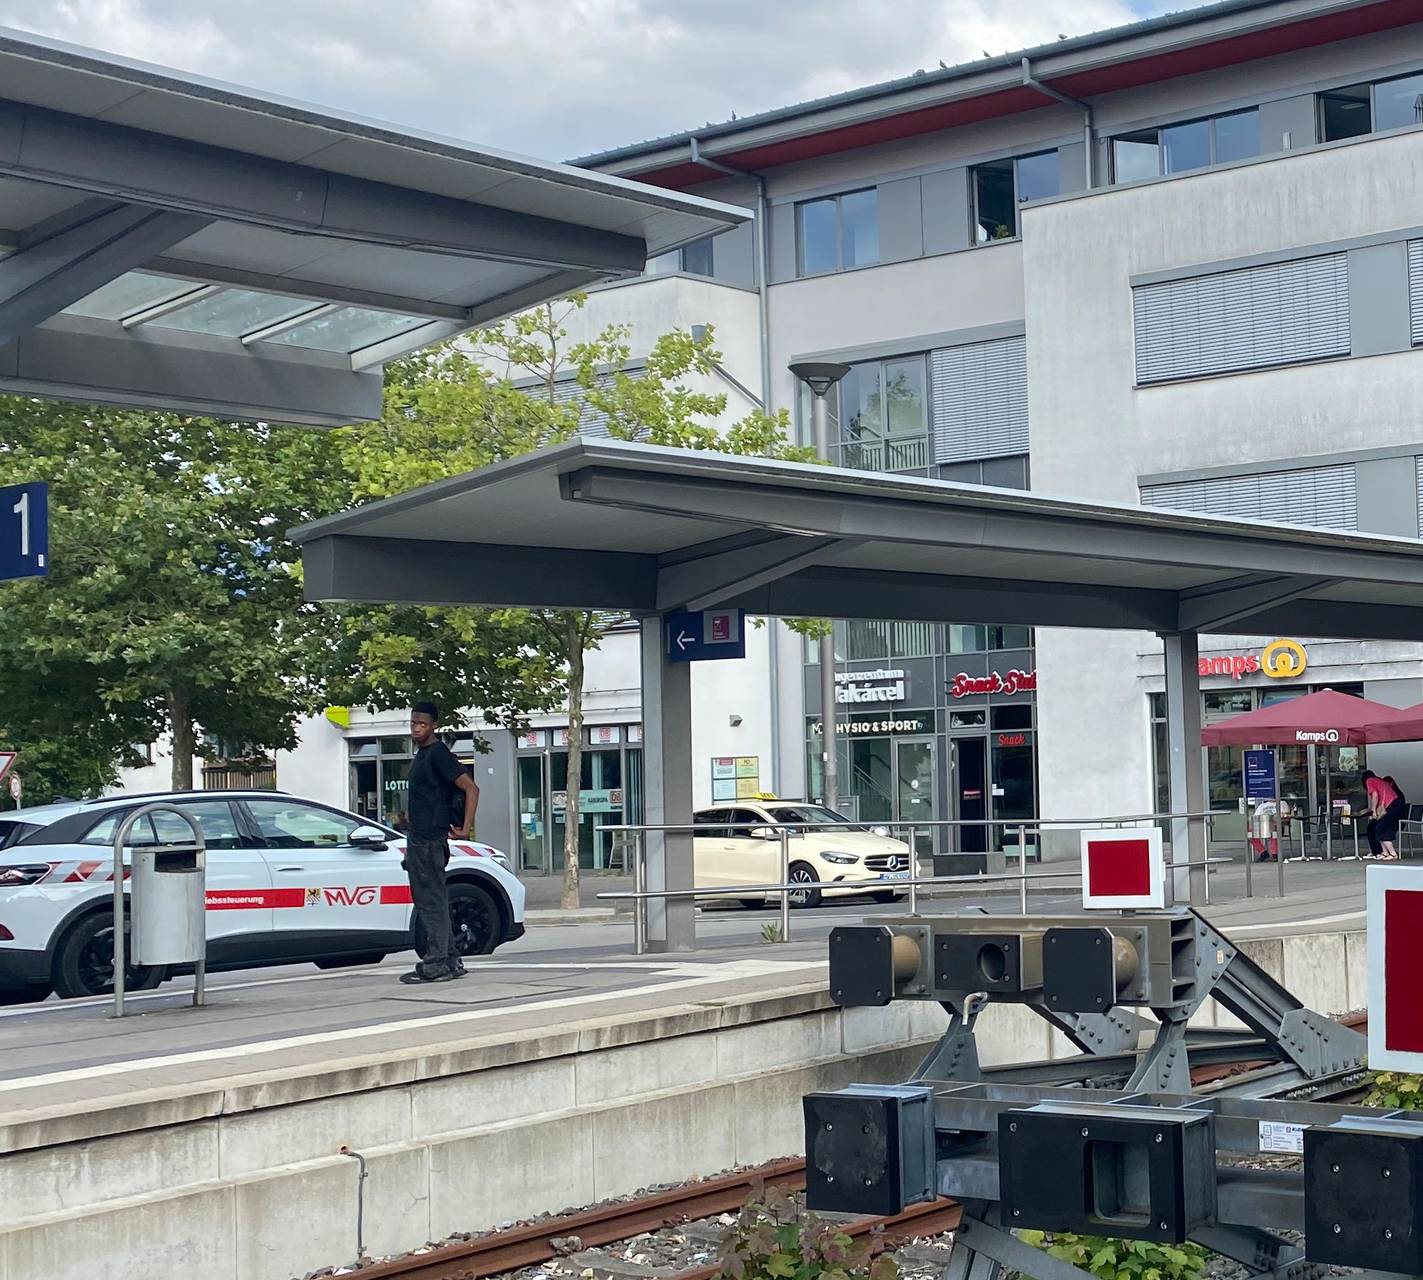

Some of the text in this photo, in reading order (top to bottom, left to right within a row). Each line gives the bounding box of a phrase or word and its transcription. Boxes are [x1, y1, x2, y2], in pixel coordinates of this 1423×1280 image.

[13, 492, 28, 555] 1
[1199, 655, 1260, 679] amps
[952, 672, 1003, 698] Snack
[836, 722, 870, 734] HYSIO
[872, 721, 879, 732] &
[881, 720, 918, 732] SPORT
[1296, 730, 1325, 743] Kamps
[999, 733, 1025, 746] Snack
[205, 886, 379, 906] iebssteuerung MVG
